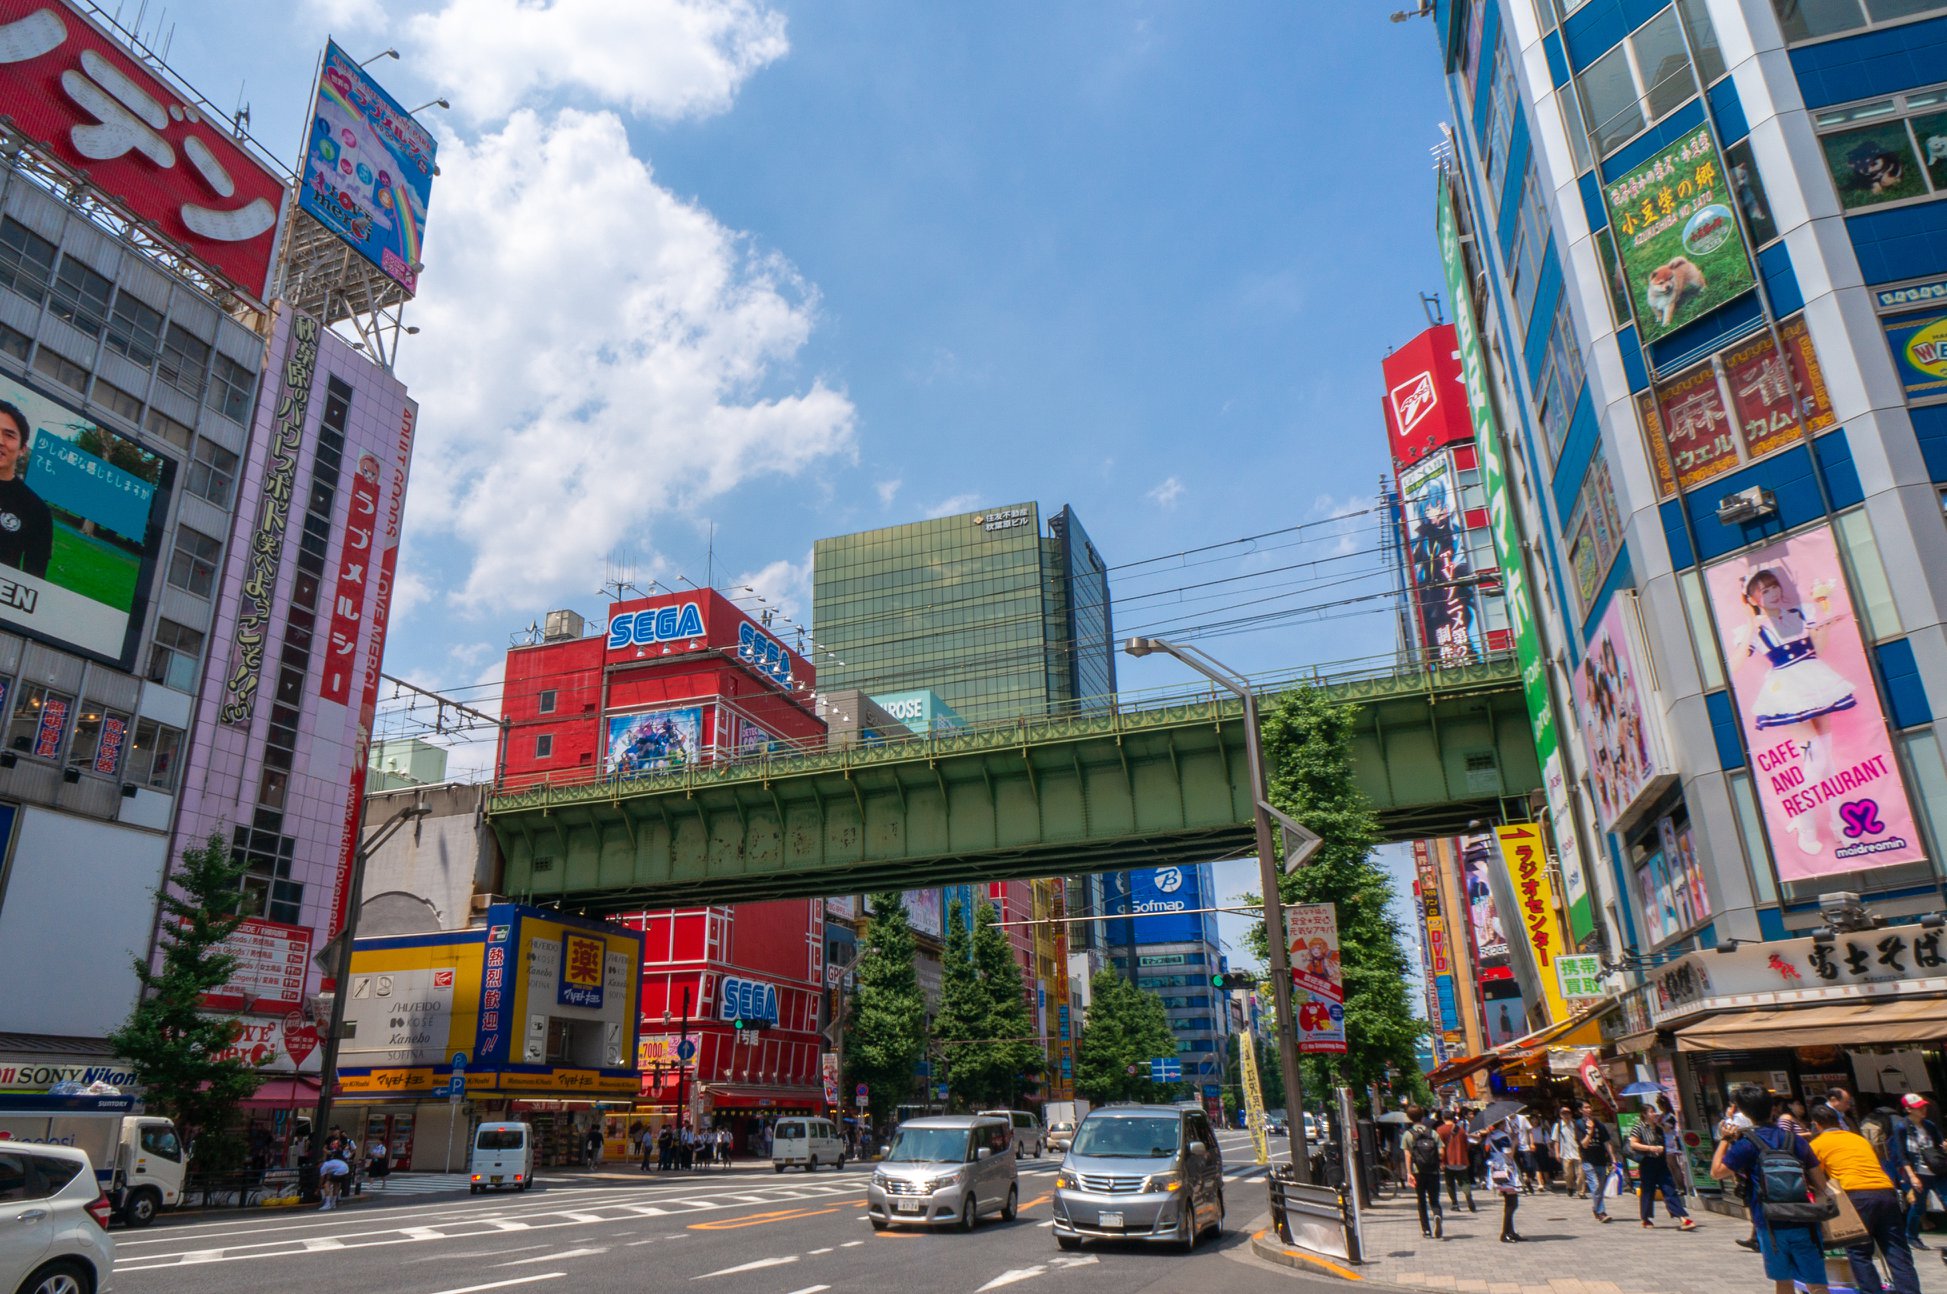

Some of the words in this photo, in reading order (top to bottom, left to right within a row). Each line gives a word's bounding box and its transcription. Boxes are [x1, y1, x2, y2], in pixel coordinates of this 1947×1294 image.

[353, 87, 429, 161] ラブメルシー
[330, 186, 374, 222] LOVE
[1622, 161, 1715, 235] 小豆柴の郷
[398, 407, 413, 466] ADULT
[38, 437, 150, 500] 少し心配な感じもしますが
[387, 467, 404, 538] GOODS
[986, 508, 1029, 523] 住友不動産
[985, 517, 1029, 532] 秋葉原ビル
[332, 490, 375, 692] ラブメルシー
[374, 571, 392, 619] LOVE
[609, 602, 706, 649] SEGA
[362, 624, 386, 689] MERCI
[738, 620, 794, 691] SEGA
[96, 717, 125, 774] 南部鉄器
[1757, 739, 1801, 773] CAFE
[1770, 765, 1805, 796] AND
[1781, 754, 1889, 818] RESTAURANT
[1835, 836, 1906, 860] maidreamin
[1132, 900, 1184, 912] Sofmap
[1516, 845, 1549, 967] ラジオセンター
[1289, 926, 1334, 936] 元気なアキバ
[570, 940, 599, 983] 薬
[1431, 930, 1447, 972] DVD
[1560, 956, 1599, 977] 携帯
[1808, 928, 1947, 979] 富士そば
[527, 966, 552, 977] Kanebo
[1563, 976, 1602, 998] 買取
[387, 1001, 441, 1013] SHISEIDO
[481, 947, 504, 1055] 熱烈歓迎!!
[724, 978, 779, 1025] SEGA
[389, 1034, 430, 1045] Kanebo
[406, 1015, 433, 1028] KOSÉ
[388, 1051, 424, 1060] SOFINA
[643, 1042, 663, 1058] 7000
[17, 1067, 82, 1084] SONY
[81, 1067, 138, 1086] Nikon
[453, 1079, 462, 1092] P
